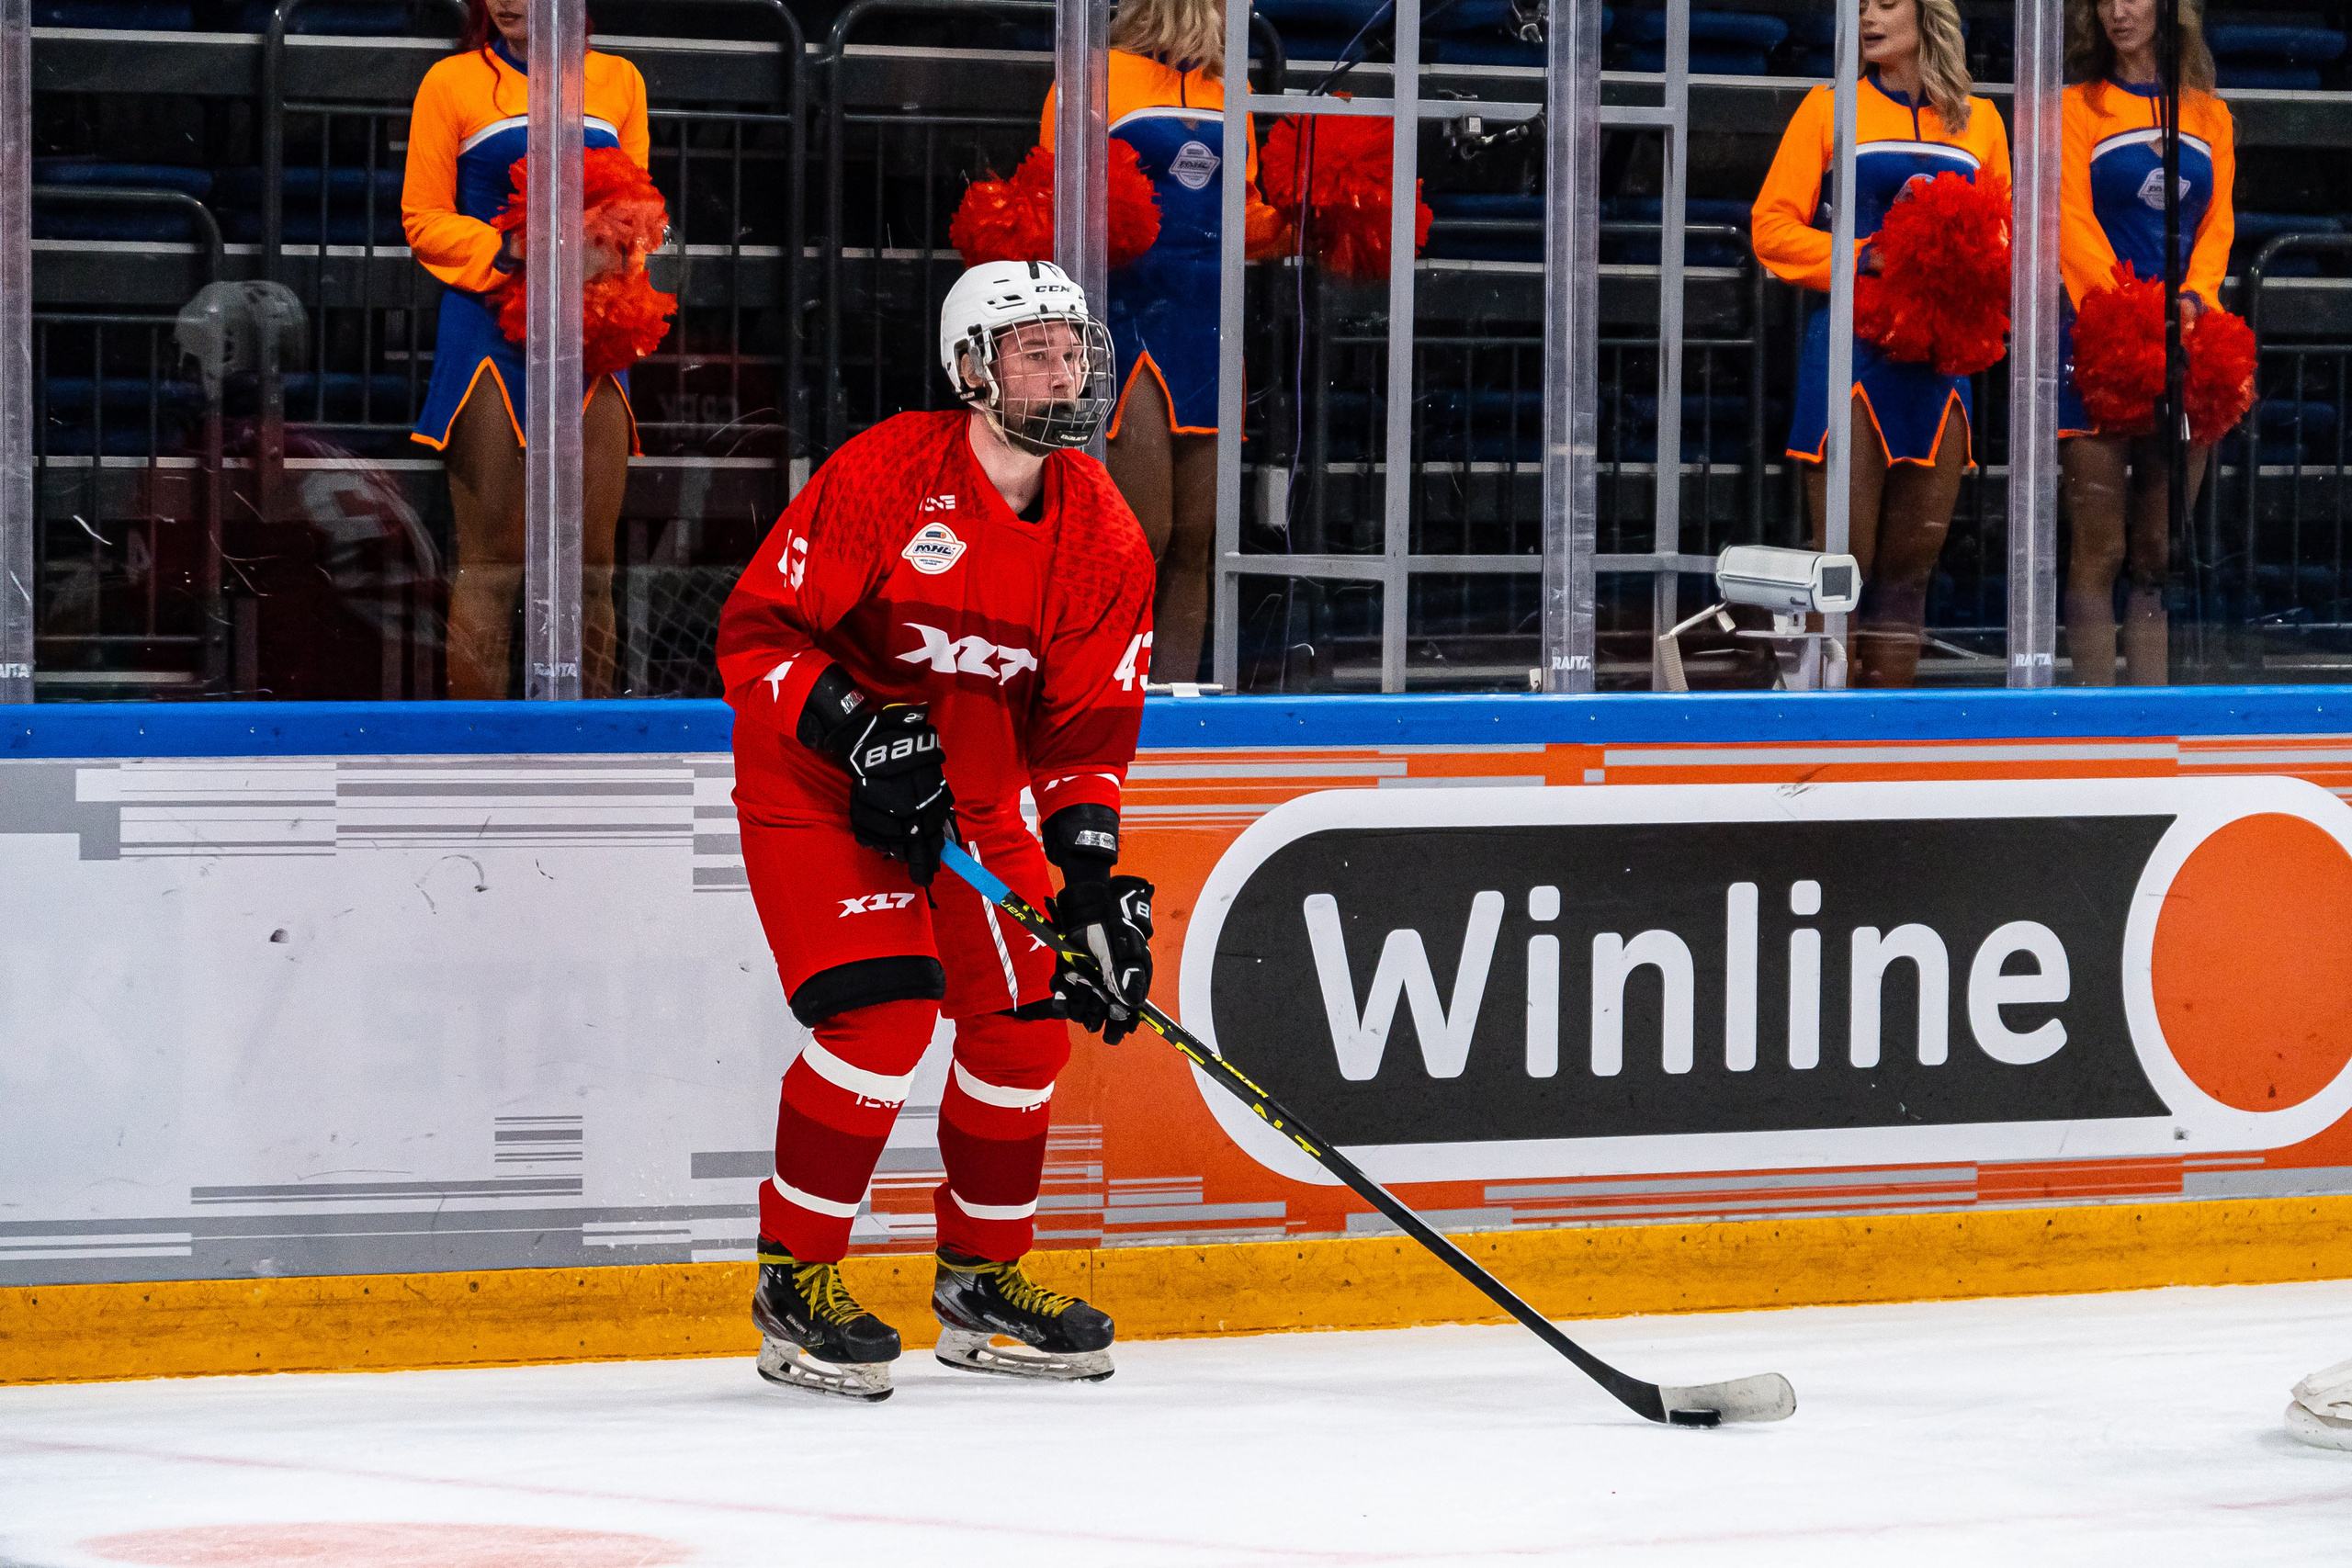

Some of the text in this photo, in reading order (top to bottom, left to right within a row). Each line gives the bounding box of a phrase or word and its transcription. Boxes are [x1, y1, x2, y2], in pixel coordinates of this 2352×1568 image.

[1035, 285, 1071, 293] CCM
[914, 544, 953, 556] MHL
[865, 733, 944, 768] BAU
[835, 892, 916, 919] X17
[1304, 879, 2070, 1081] Winline
